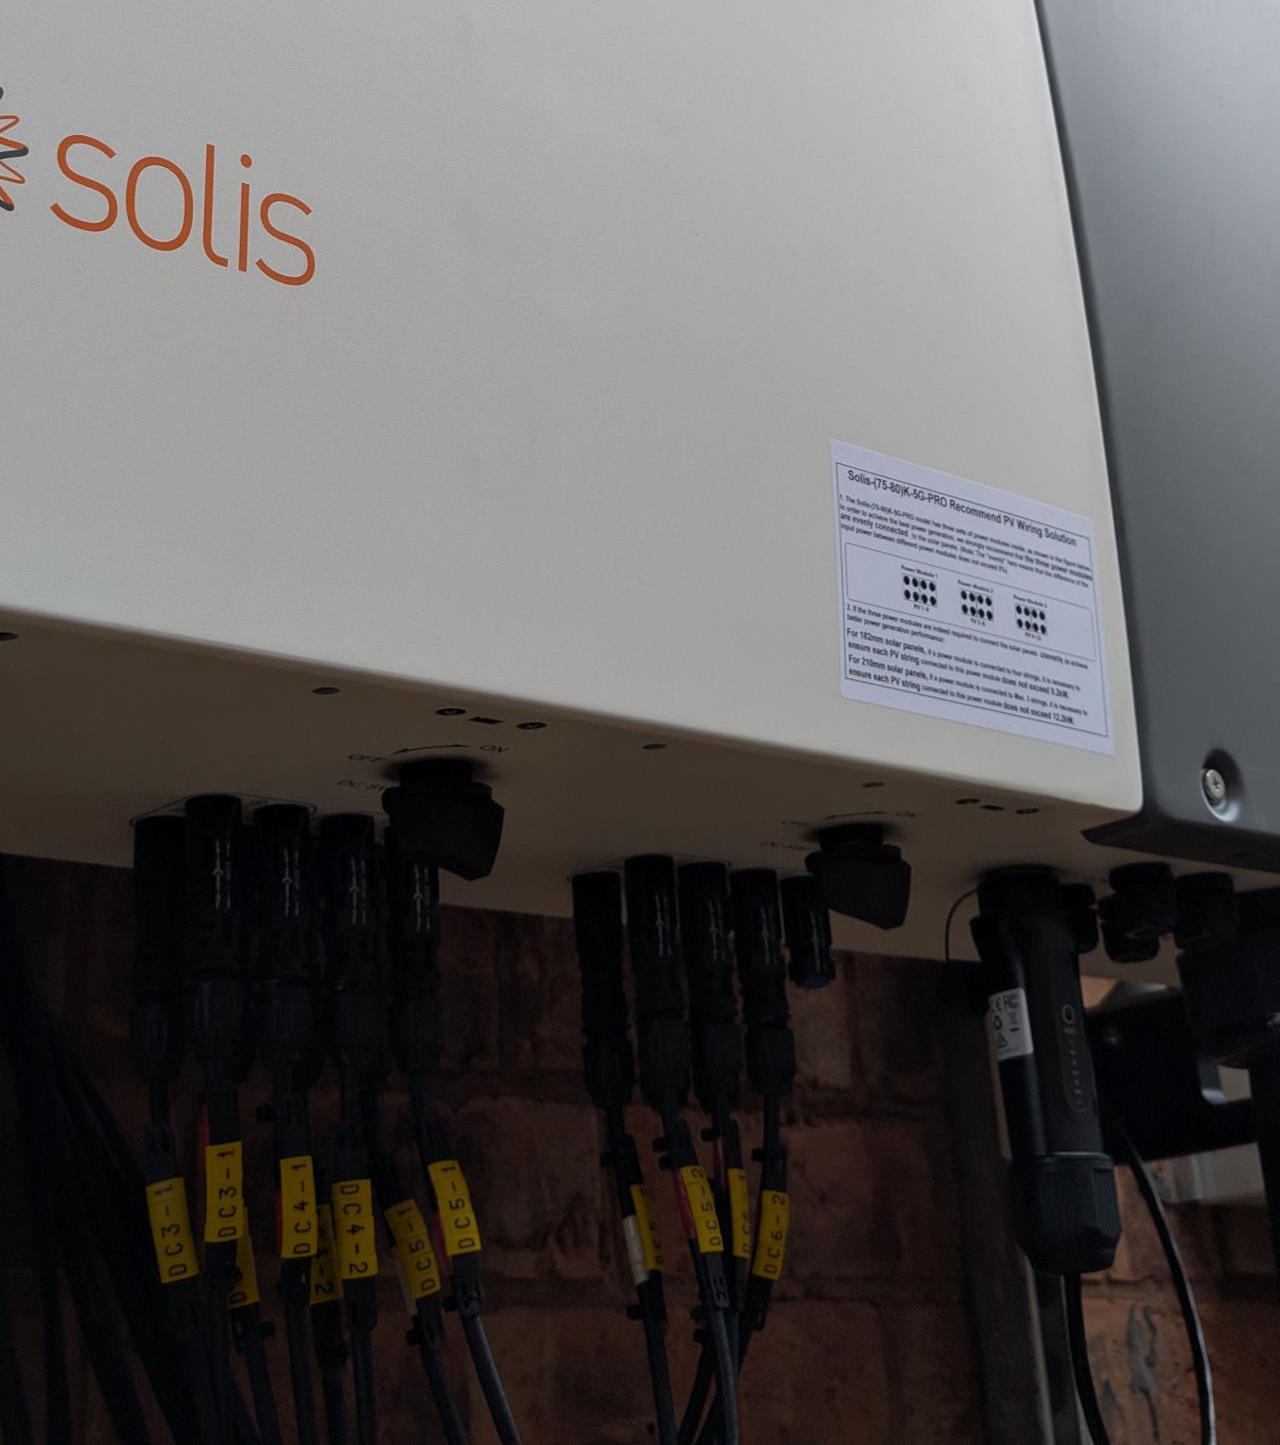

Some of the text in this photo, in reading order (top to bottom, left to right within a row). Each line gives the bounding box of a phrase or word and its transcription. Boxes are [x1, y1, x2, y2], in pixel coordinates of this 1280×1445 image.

[49, 134, 316, 287] solis
[847, 469, 1076, 546] Solis-(75-80)K-5G-PRO Recommend PV Wiring Solution
[889, 649, 899, 658] PV
[890, 675, 900, 685] PV
[154, 1183, 188, 1276] DC3-1
[216, 1148, 236, 1238] DC3-1
[291, 1160, 312, 1254] DC4-1
[340, 1183, 369, 1275] DC4-2
[440, 1162, 476, 1250] DC5-1
[691, 1167, 722, 1246] DC5-2
[763, 1193, 787, 1274] DC6-2
[396, 1204, 437, 1291] DC5-1
